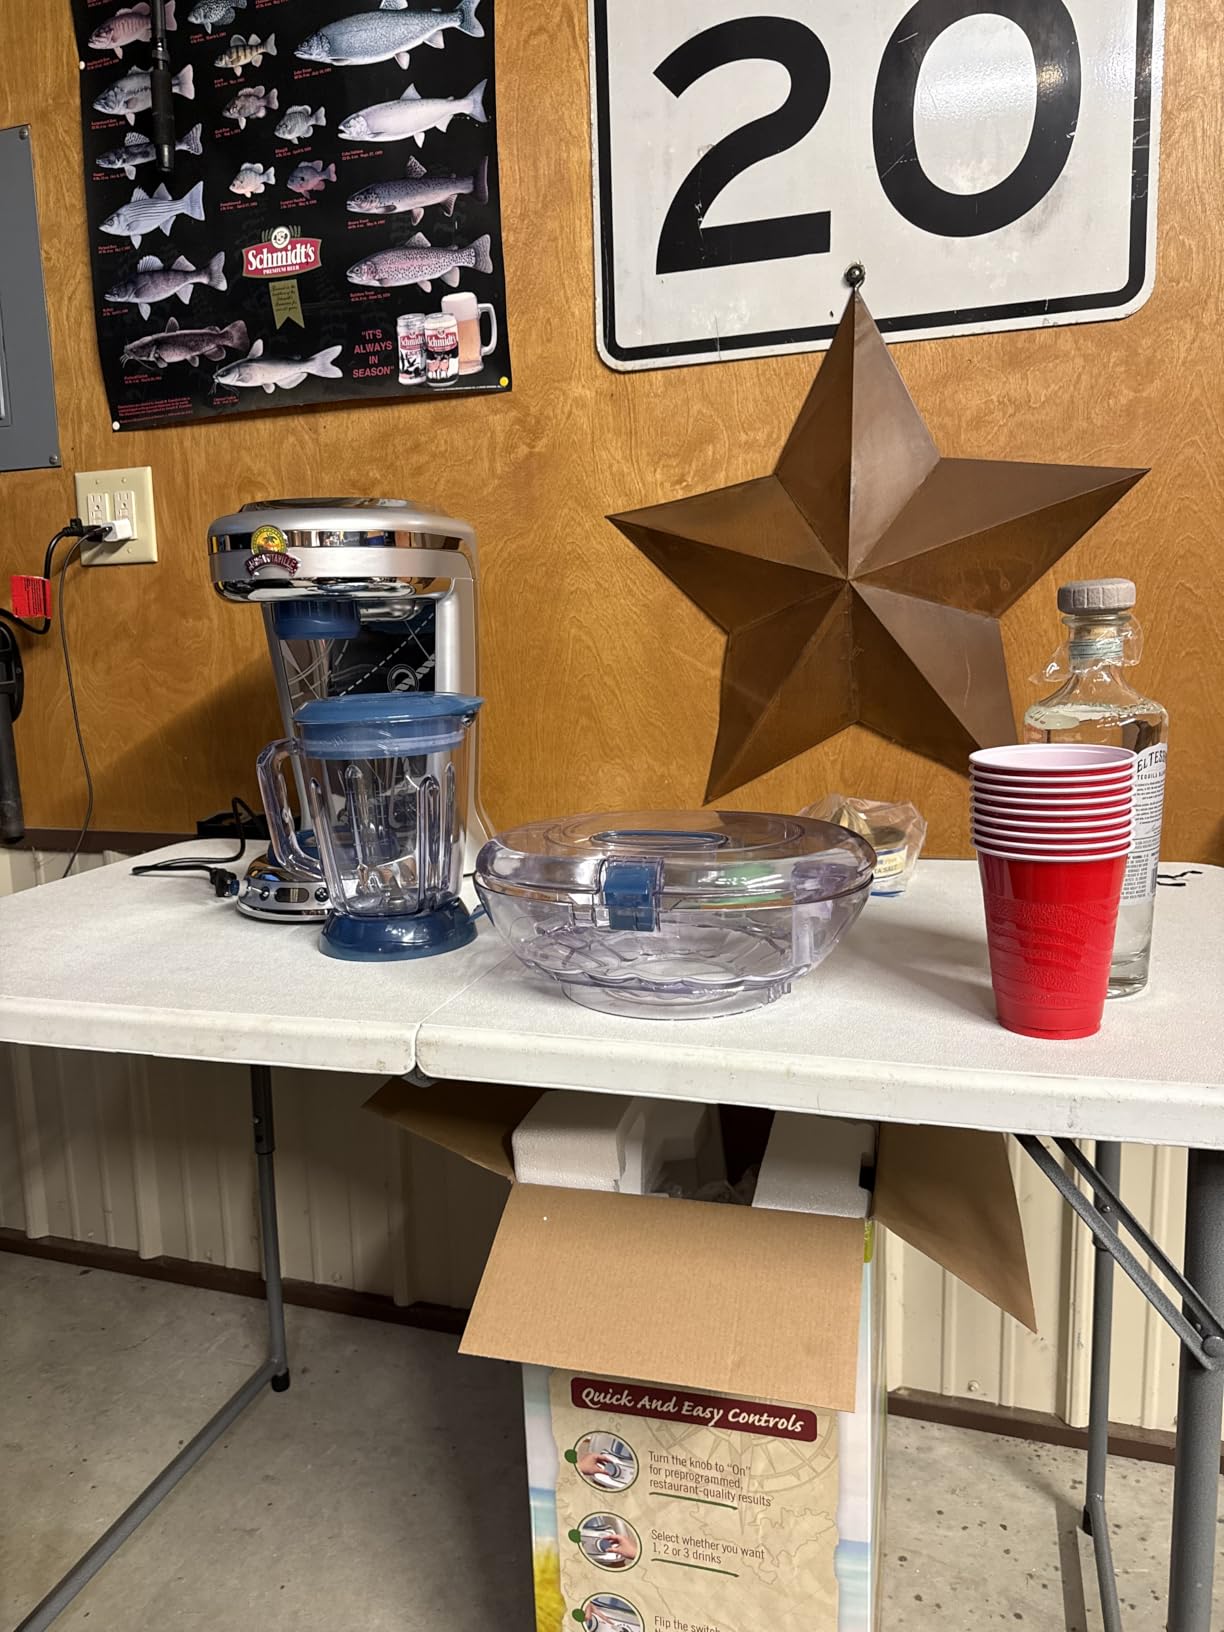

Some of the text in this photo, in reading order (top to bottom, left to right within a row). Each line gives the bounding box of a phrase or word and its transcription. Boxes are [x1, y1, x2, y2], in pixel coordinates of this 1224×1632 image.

[653, 0, 1081, 275] 20
[248, 243, 315, 271] Schmidt's
[263, 267, 286, 275] PREMIUM
[354, 341, 393, 354] ALWAYS
[369, 355, 378, 364] IN
[1137, 759, 1148, 773] EL
[582, 1387, 804, 1432] Quick And Easy Controls
[648, 1450, 669, 1463] Turn
[671, 1455, 687, 1467] the
[689, 1457, 712, 1470] knob
[715, 1461, 725, 1473] to
[649, 1464, 743, 1490] for preprogrammed,
[649, 1479, 771, 1507] restaurant-quality results
[651, 1529, 765, 1560] Select whether you want
[653, 1542, 722, 1564] 1, 2 or 3 drinks
[654, 1615, 671, 1629] Flip
[673, 1619, 688, 1631] the
